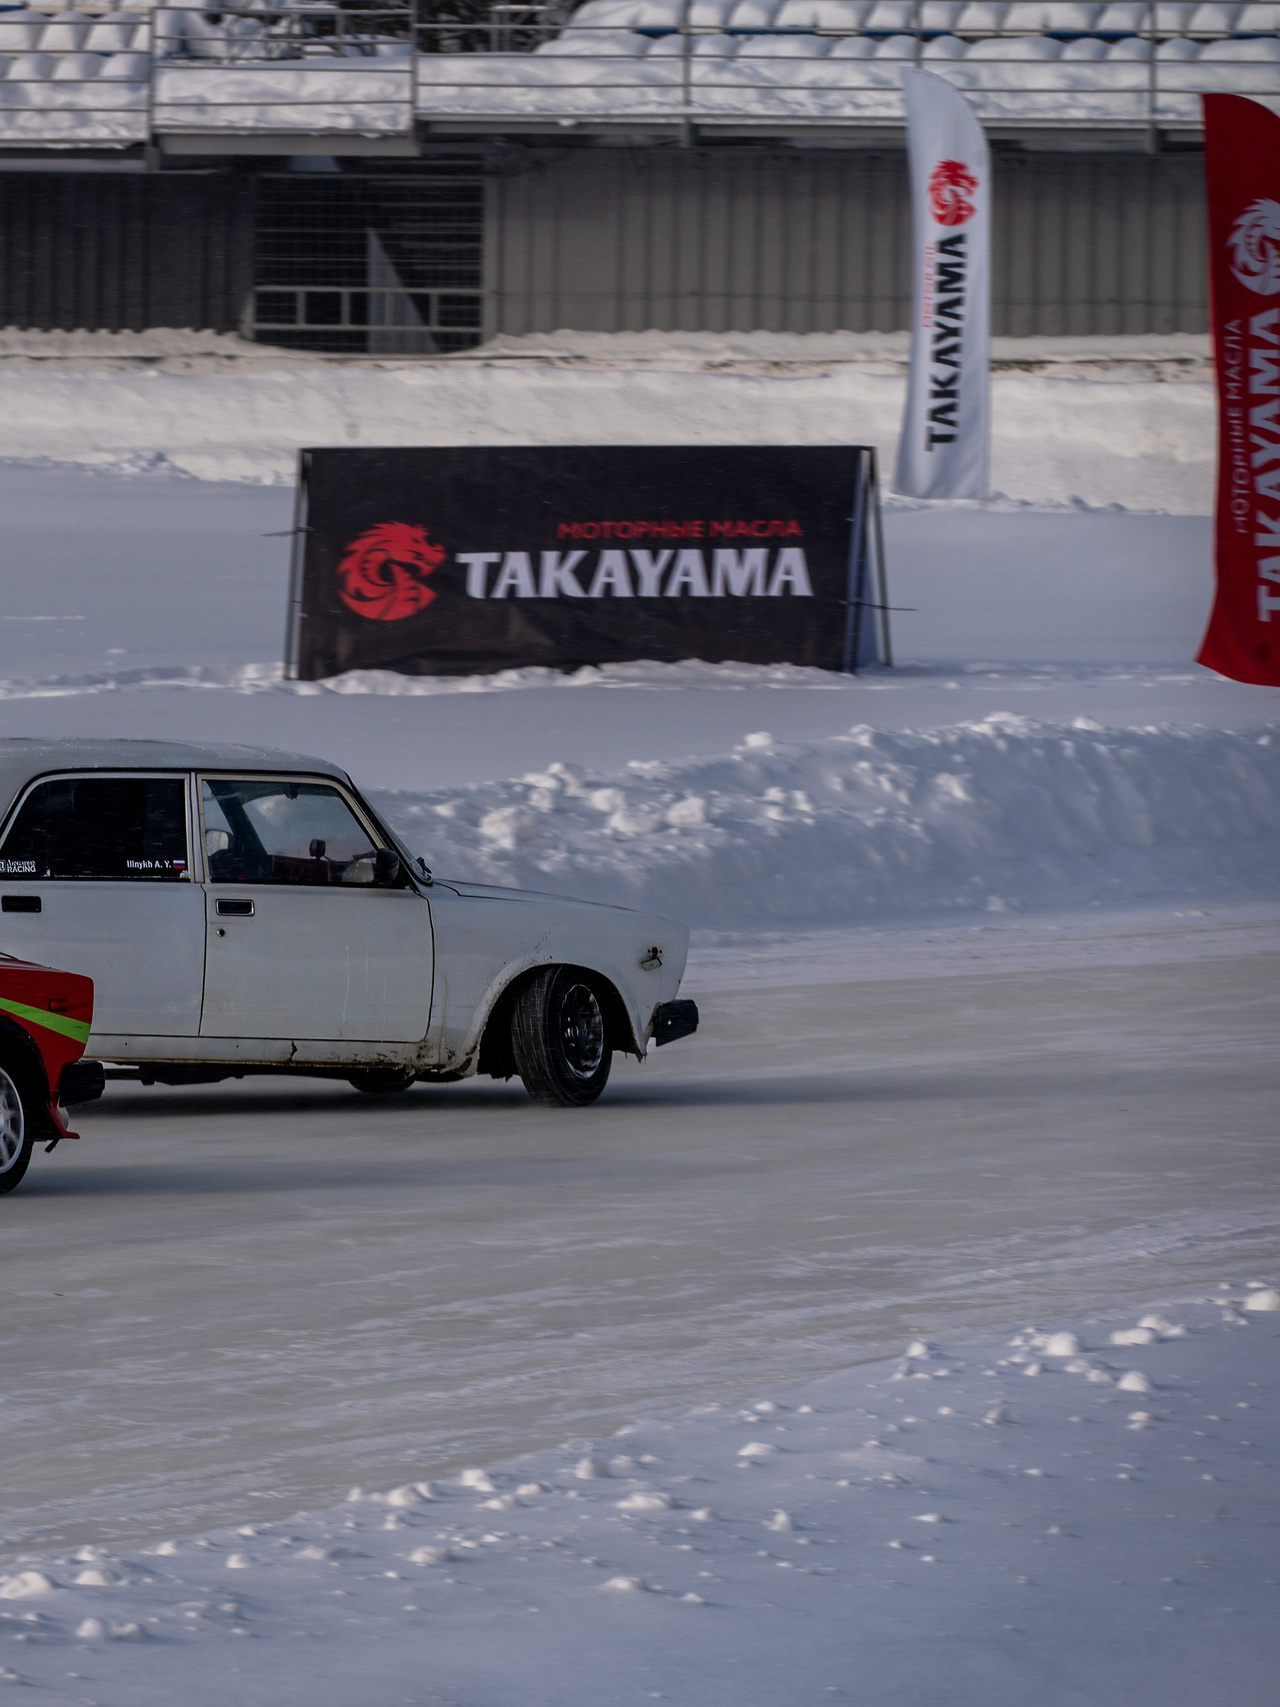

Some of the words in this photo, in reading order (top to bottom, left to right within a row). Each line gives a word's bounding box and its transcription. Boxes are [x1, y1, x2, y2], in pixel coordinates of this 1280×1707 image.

[925, 232, 967, 452] TAKAYAMA
[1224, 319, 1243, 400] МАСЛА
[1226, 406, 1250, 534] МОТОРНЫЕ
[557, 521, 705, 539] МОТОРНЫЕ
[709, 520, 803, 538] МАСЛА
[455, 548, 814, 599] TAKAYAMA
[7, 865, 36, 873] RACING
[154, 860, 163, 868] A.
[164, 860, 171, 868] Y.
